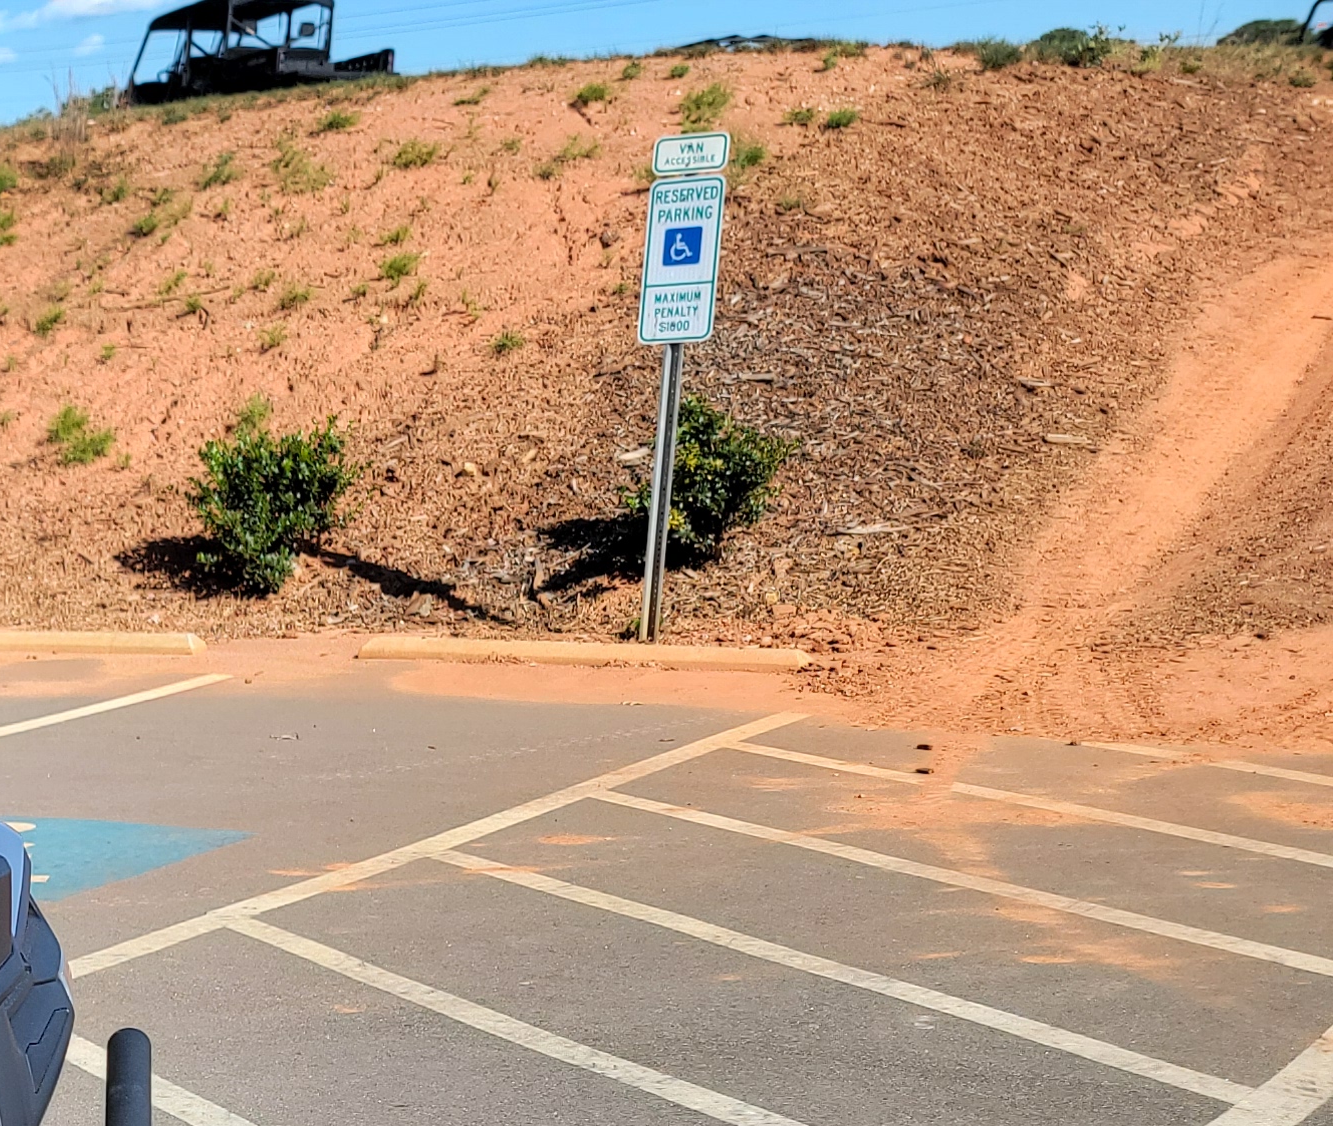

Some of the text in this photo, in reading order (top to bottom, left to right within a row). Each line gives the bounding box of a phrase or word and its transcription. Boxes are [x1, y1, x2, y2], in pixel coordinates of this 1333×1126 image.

[679, 142, 704, 154] VAN
[664, 154, 716, 166] ACCESSIBLE
[655, 186, 719, 205] RESERVED
[657, 205, 713, 223] PARKING
[654, 290, 702, 305] MAXIMUM
[654, 305, 699, 319] PENALTY
